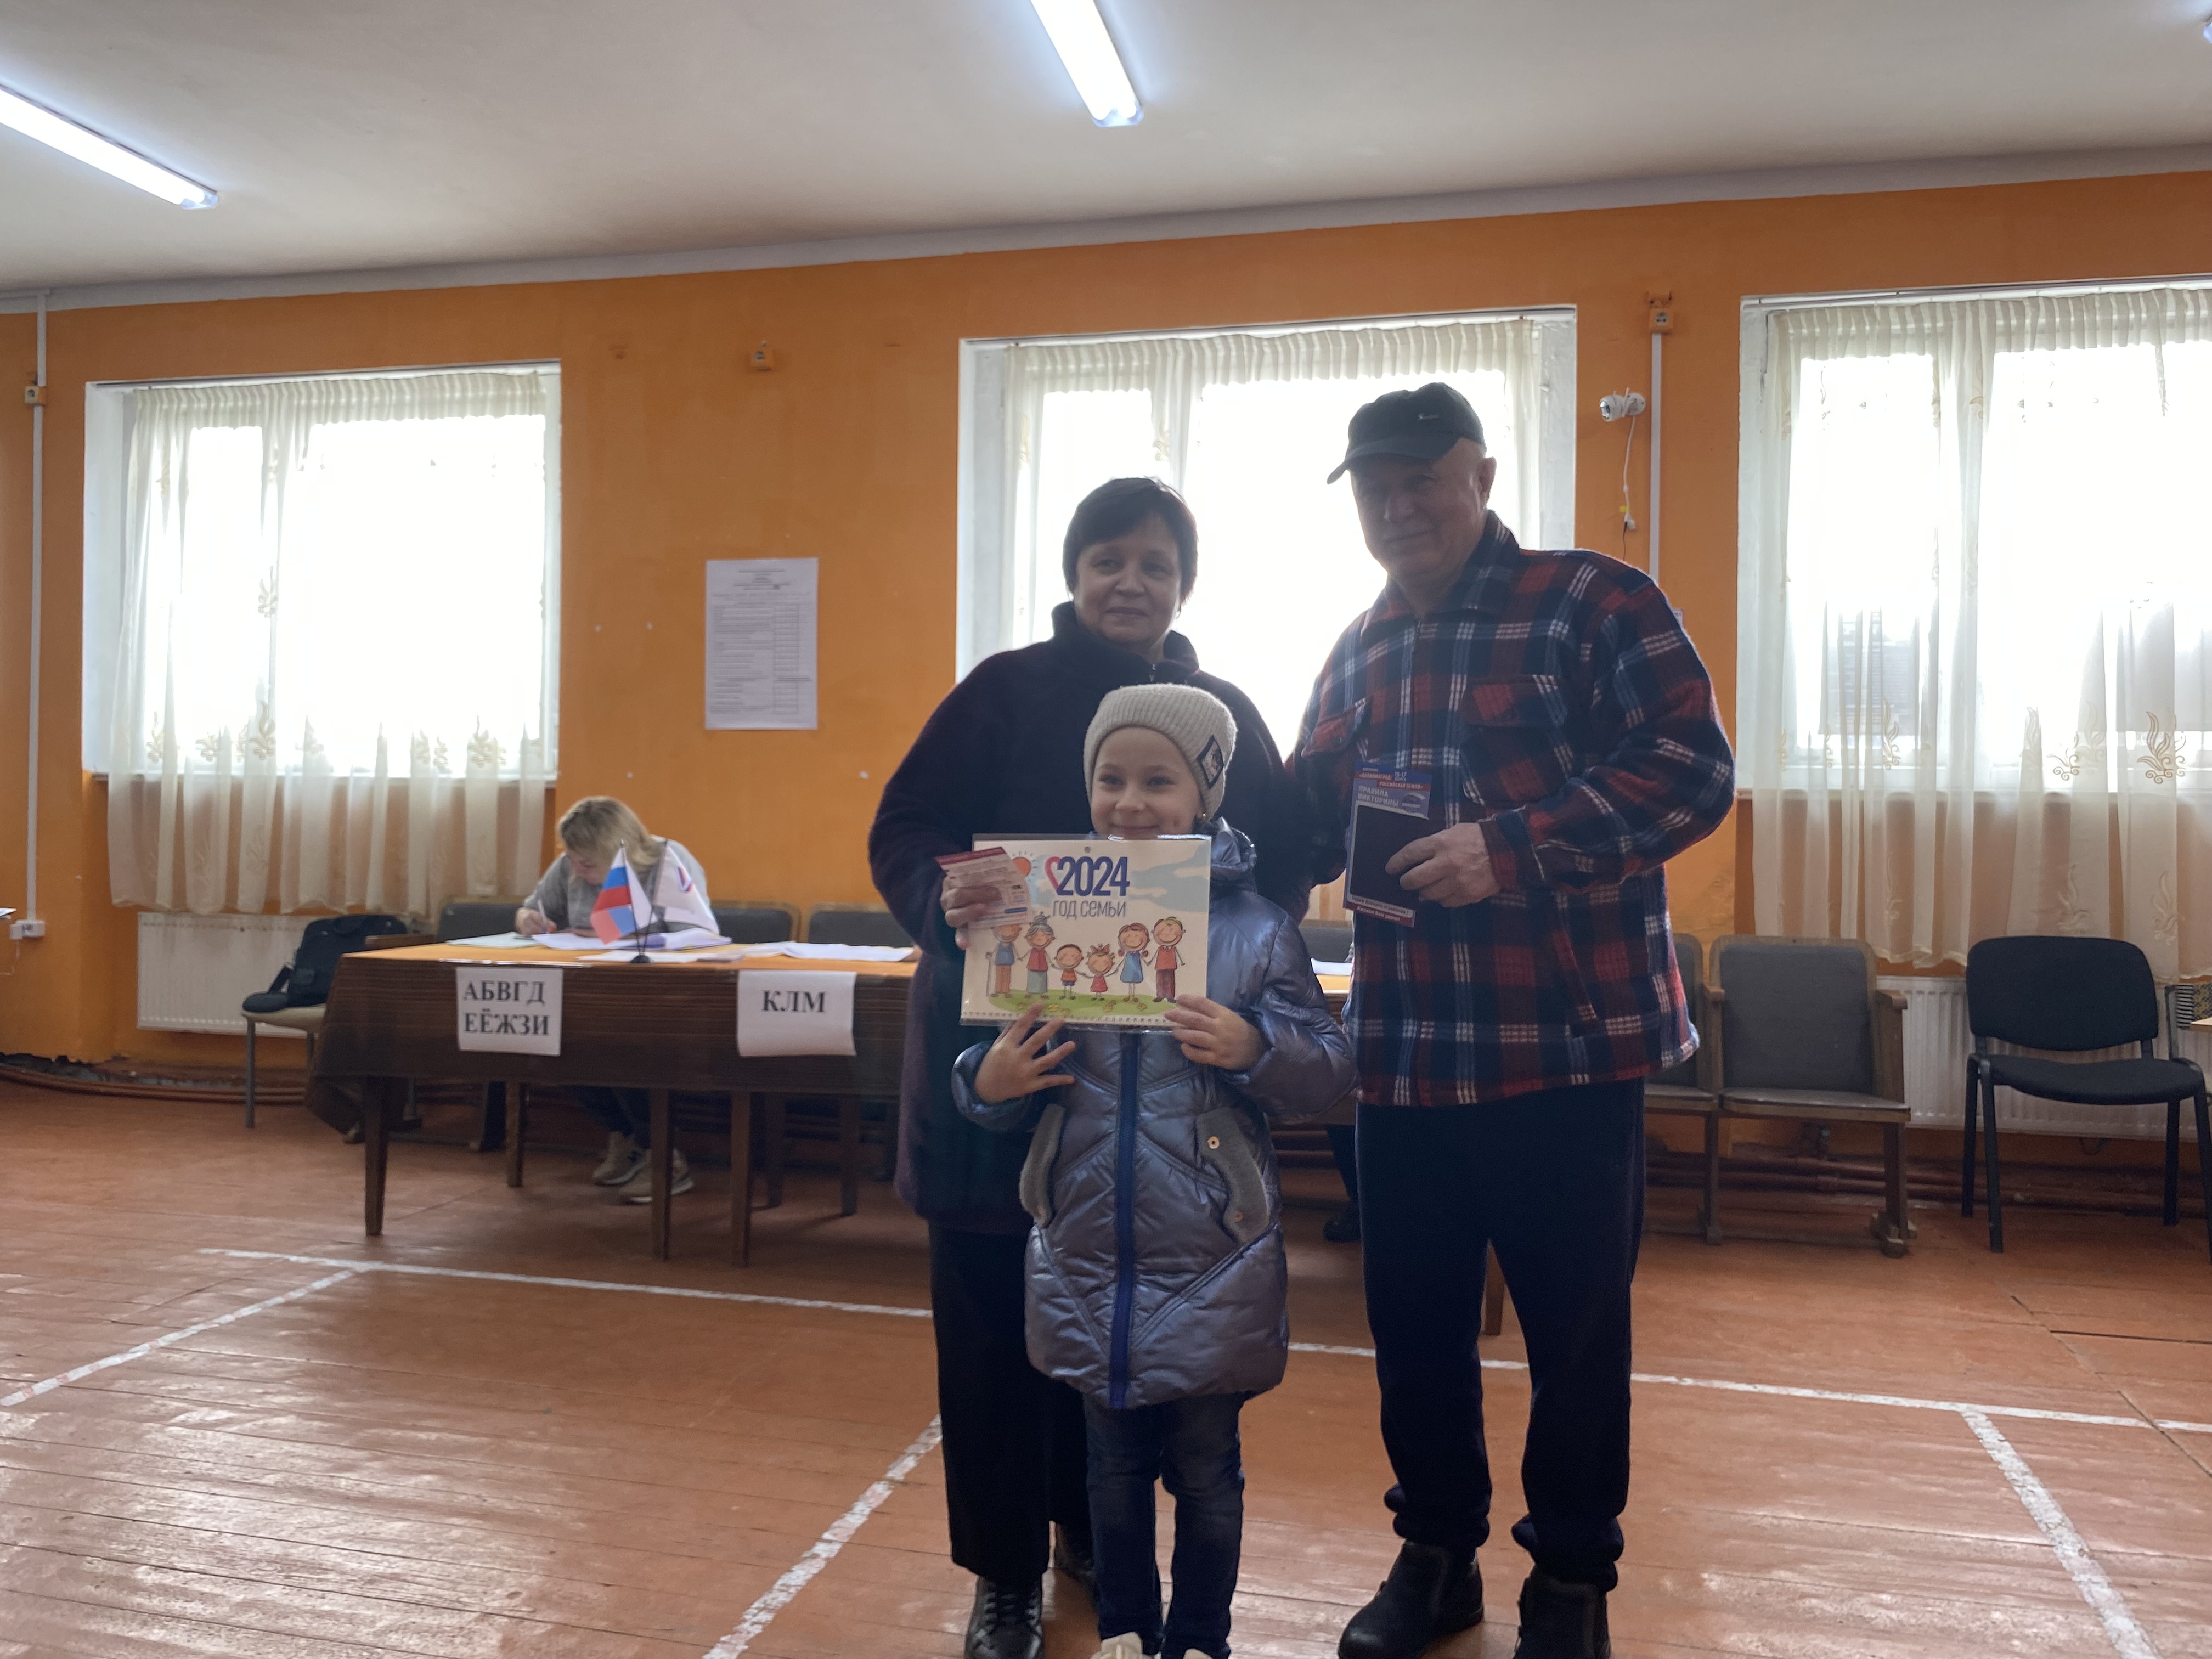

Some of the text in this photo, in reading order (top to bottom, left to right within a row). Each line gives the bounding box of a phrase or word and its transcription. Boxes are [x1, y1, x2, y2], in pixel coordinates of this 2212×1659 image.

[1357, 793, 1398, 807] ВИКТОРИНЫ
[1358, 785, 1389, 798] ПРАВИЛА
[1057, 856, 1130, 896] 2024
[1053, 900, 1077, 920] ГОД
[464, 980, 545, 1006] АБВГД
[761, 990, 827, 1013] КЛМ
[464, 1008, 550, 1036] ЕЁЖЗИ
